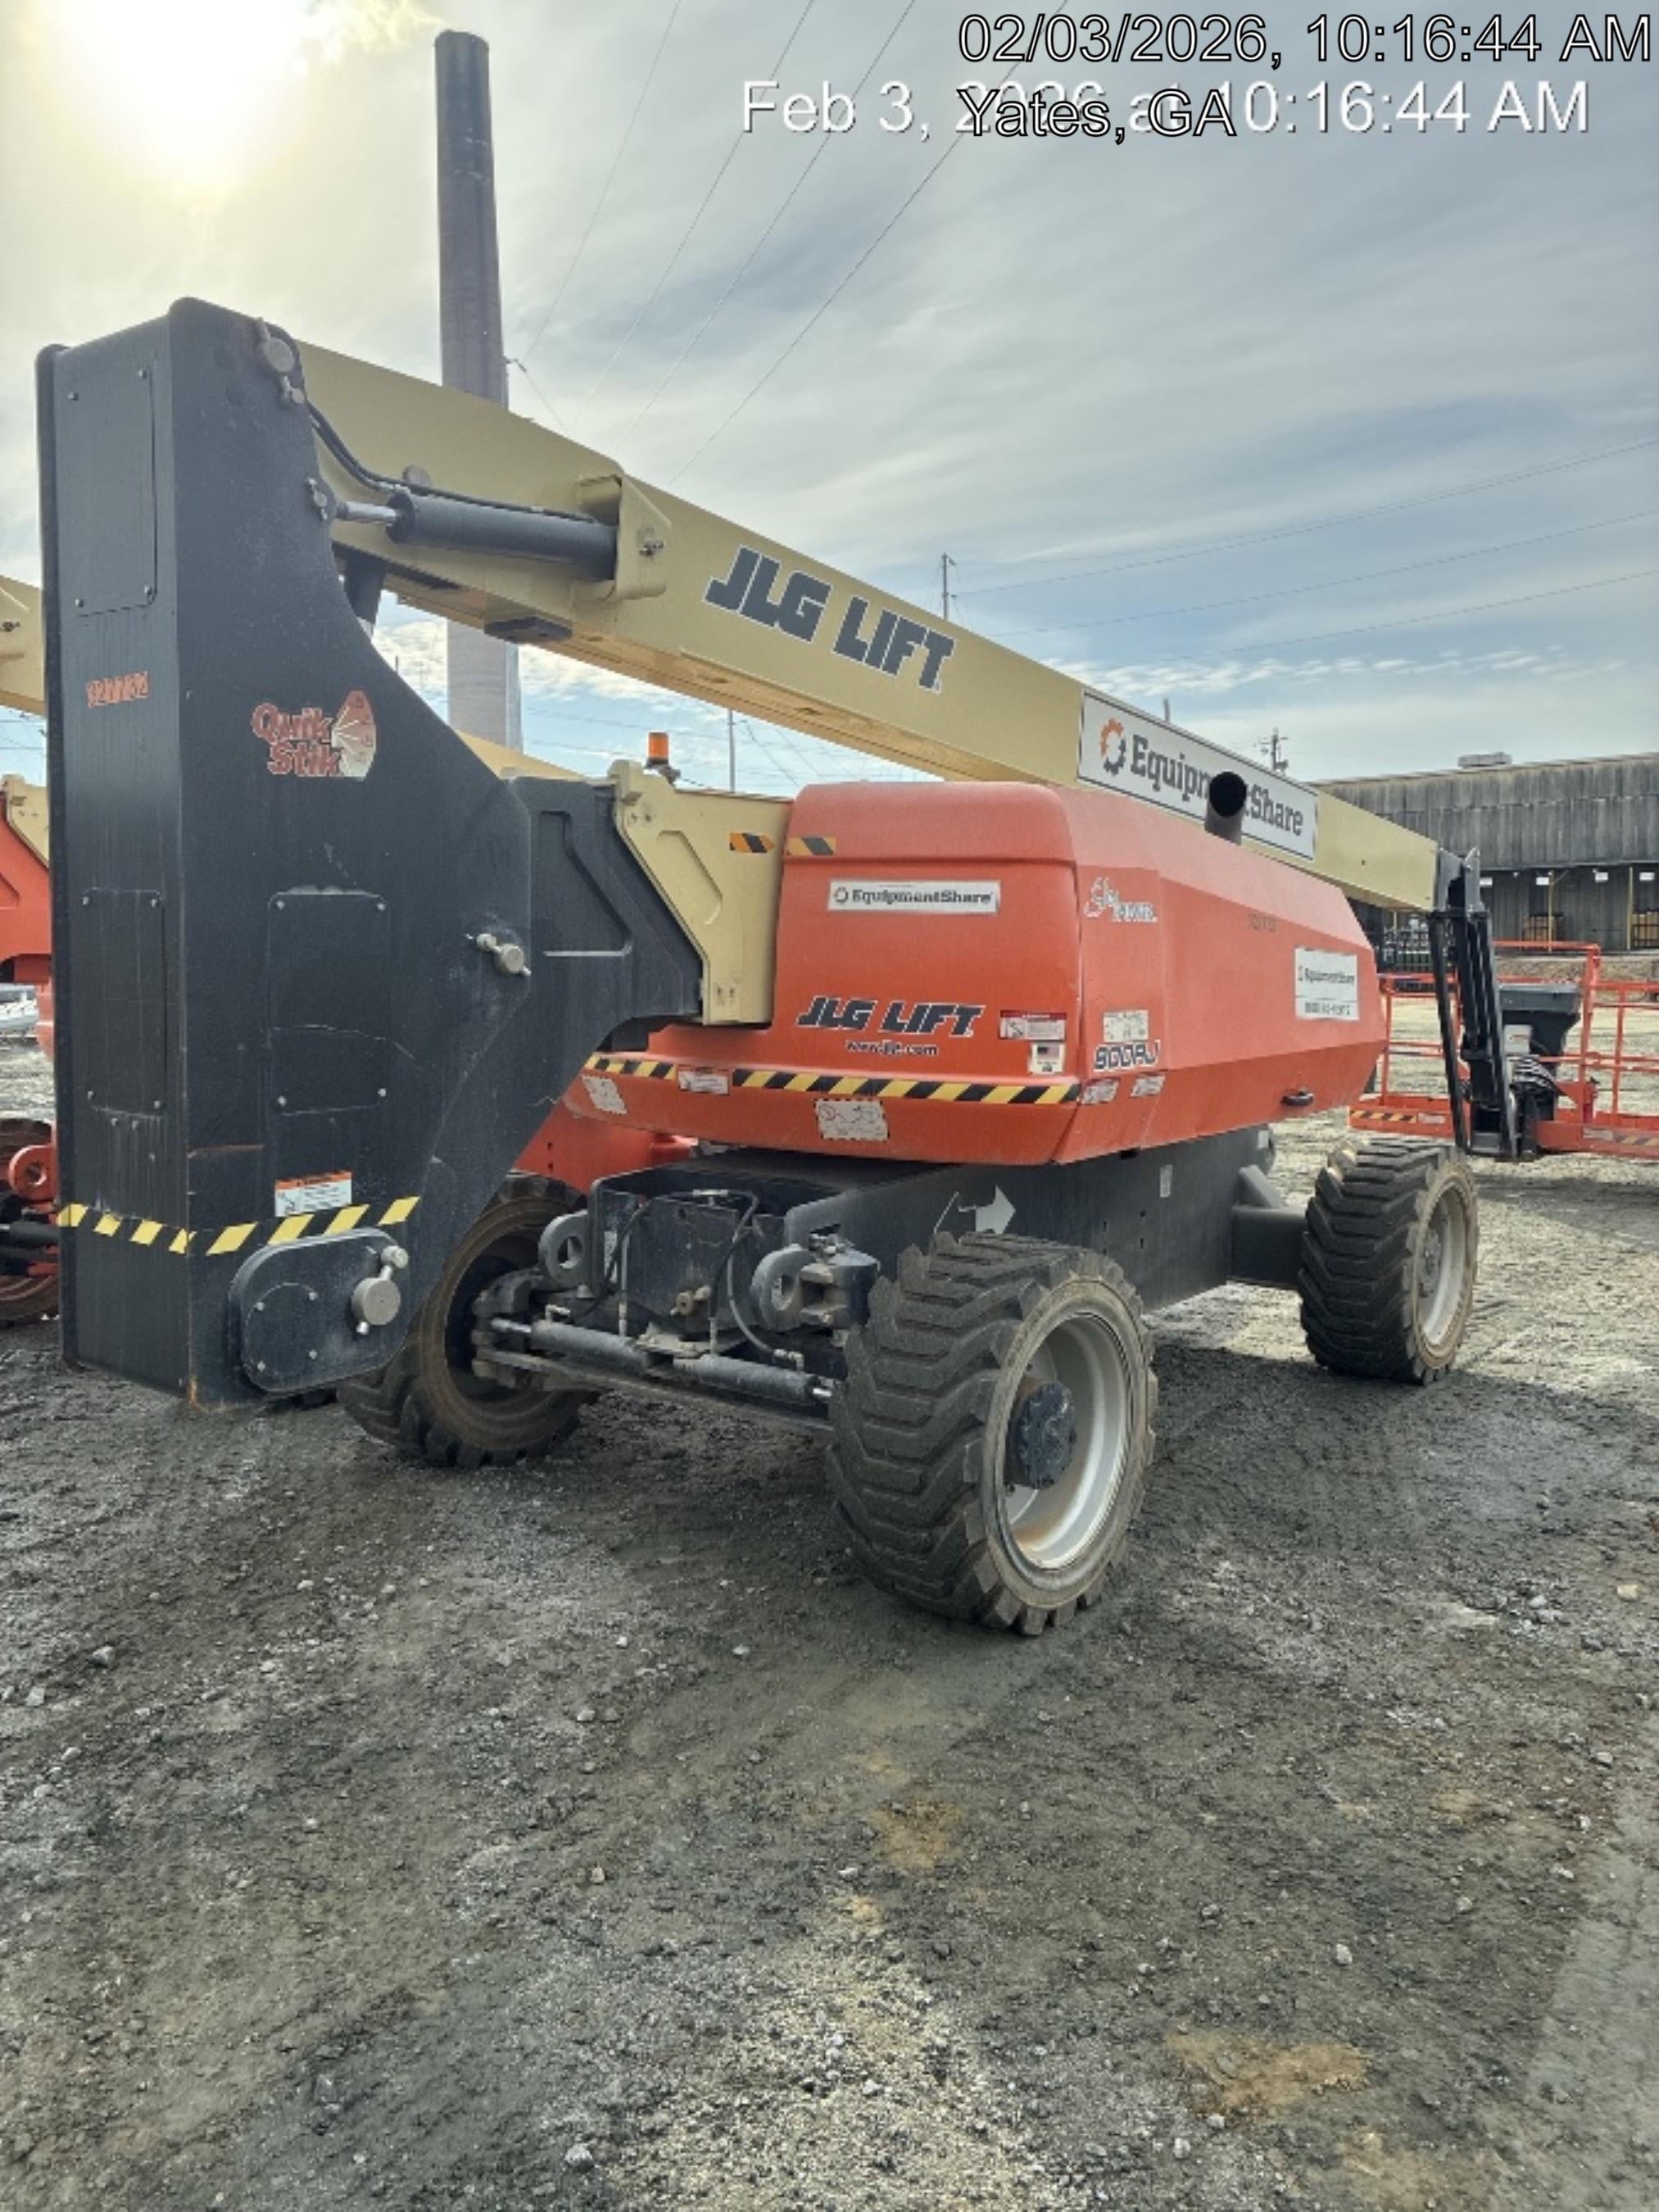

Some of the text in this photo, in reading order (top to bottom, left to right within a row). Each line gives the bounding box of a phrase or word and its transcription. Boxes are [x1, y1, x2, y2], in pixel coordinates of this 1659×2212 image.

[701, 544, 957, 695] JLG LIFT
[251, 703, 335, 745] Quik
[266, 741, 342, 777] Stik
[1130, 734, 1304, 836] EquipShare
[852, 889, 993, 905] EquipmentShare
[796, 995, 878, 1031] JLG
[877, 999, 986, 1038] LIFT
